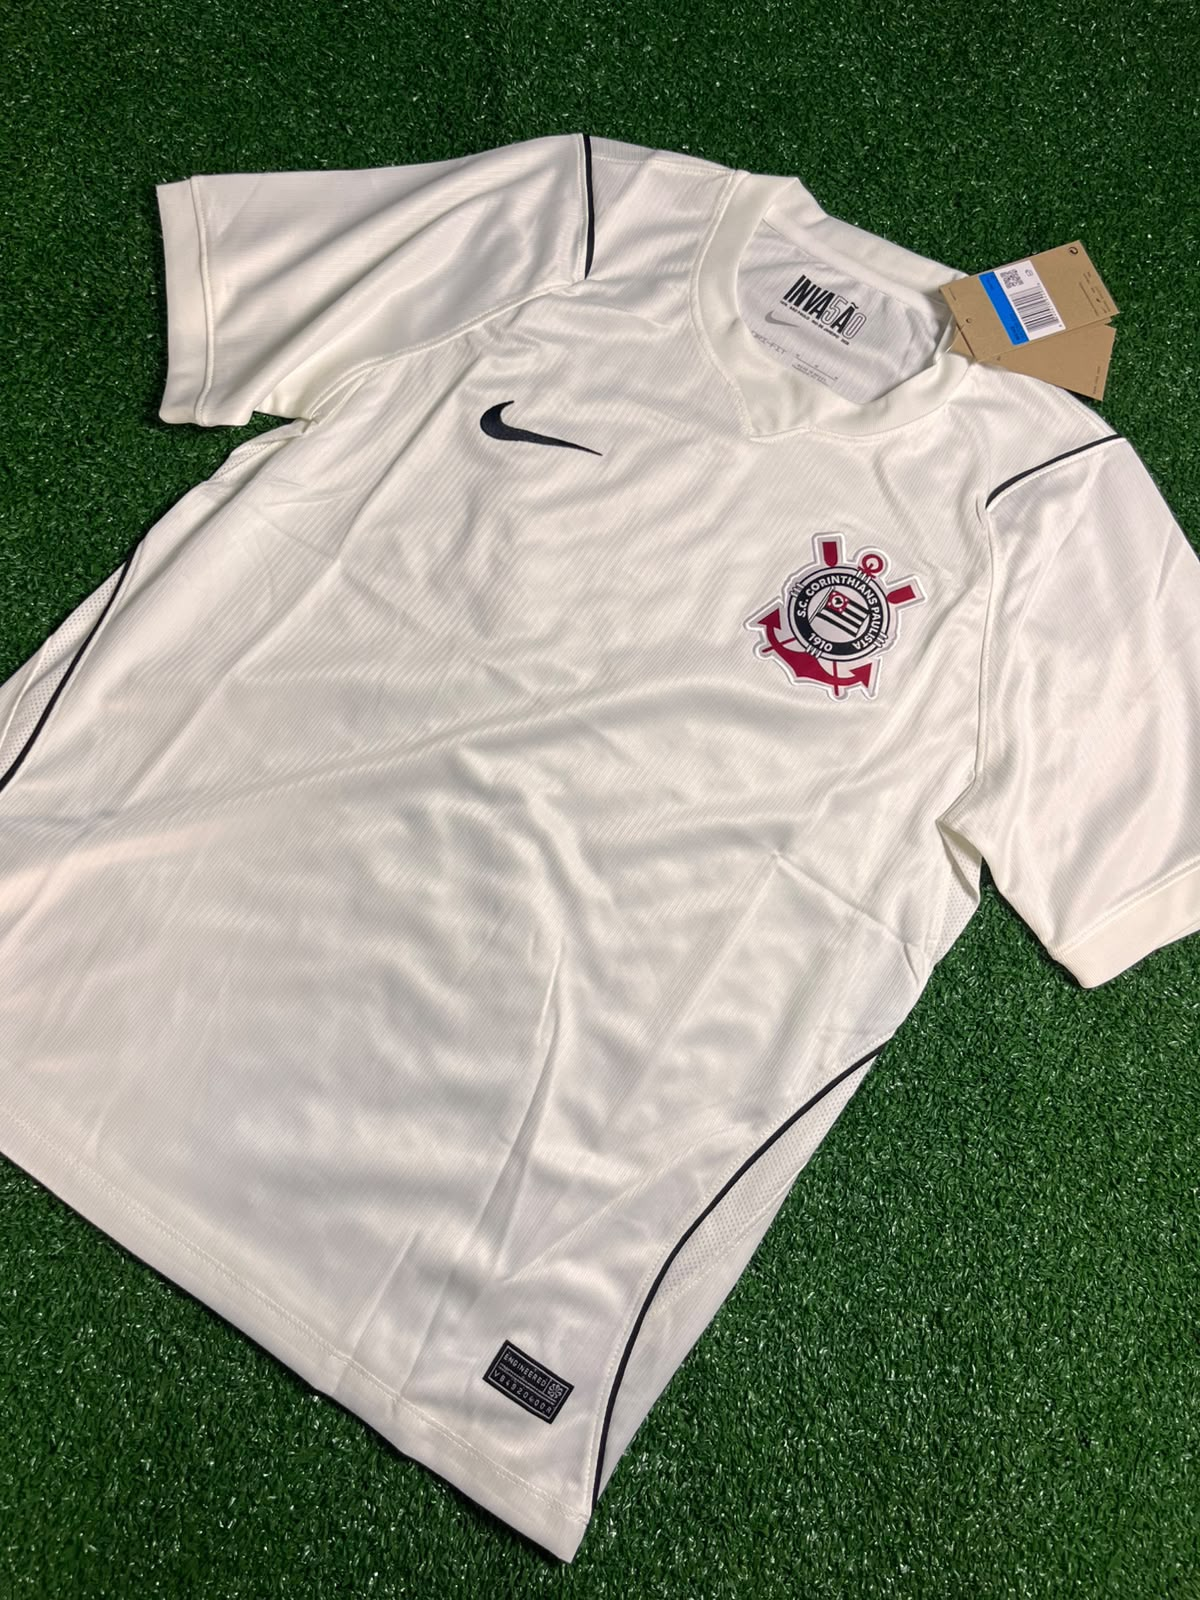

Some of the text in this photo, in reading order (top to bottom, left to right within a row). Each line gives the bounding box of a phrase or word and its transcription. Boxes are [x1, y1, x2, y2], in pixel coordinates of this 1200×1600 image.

[806, 575, 878, 605] CORINTHIANS
[852, 607, 881, 650] PAULISTA
[808, 633, 833, 652] 1910
[503, 1353, 547, 1387] ENGINEERED
